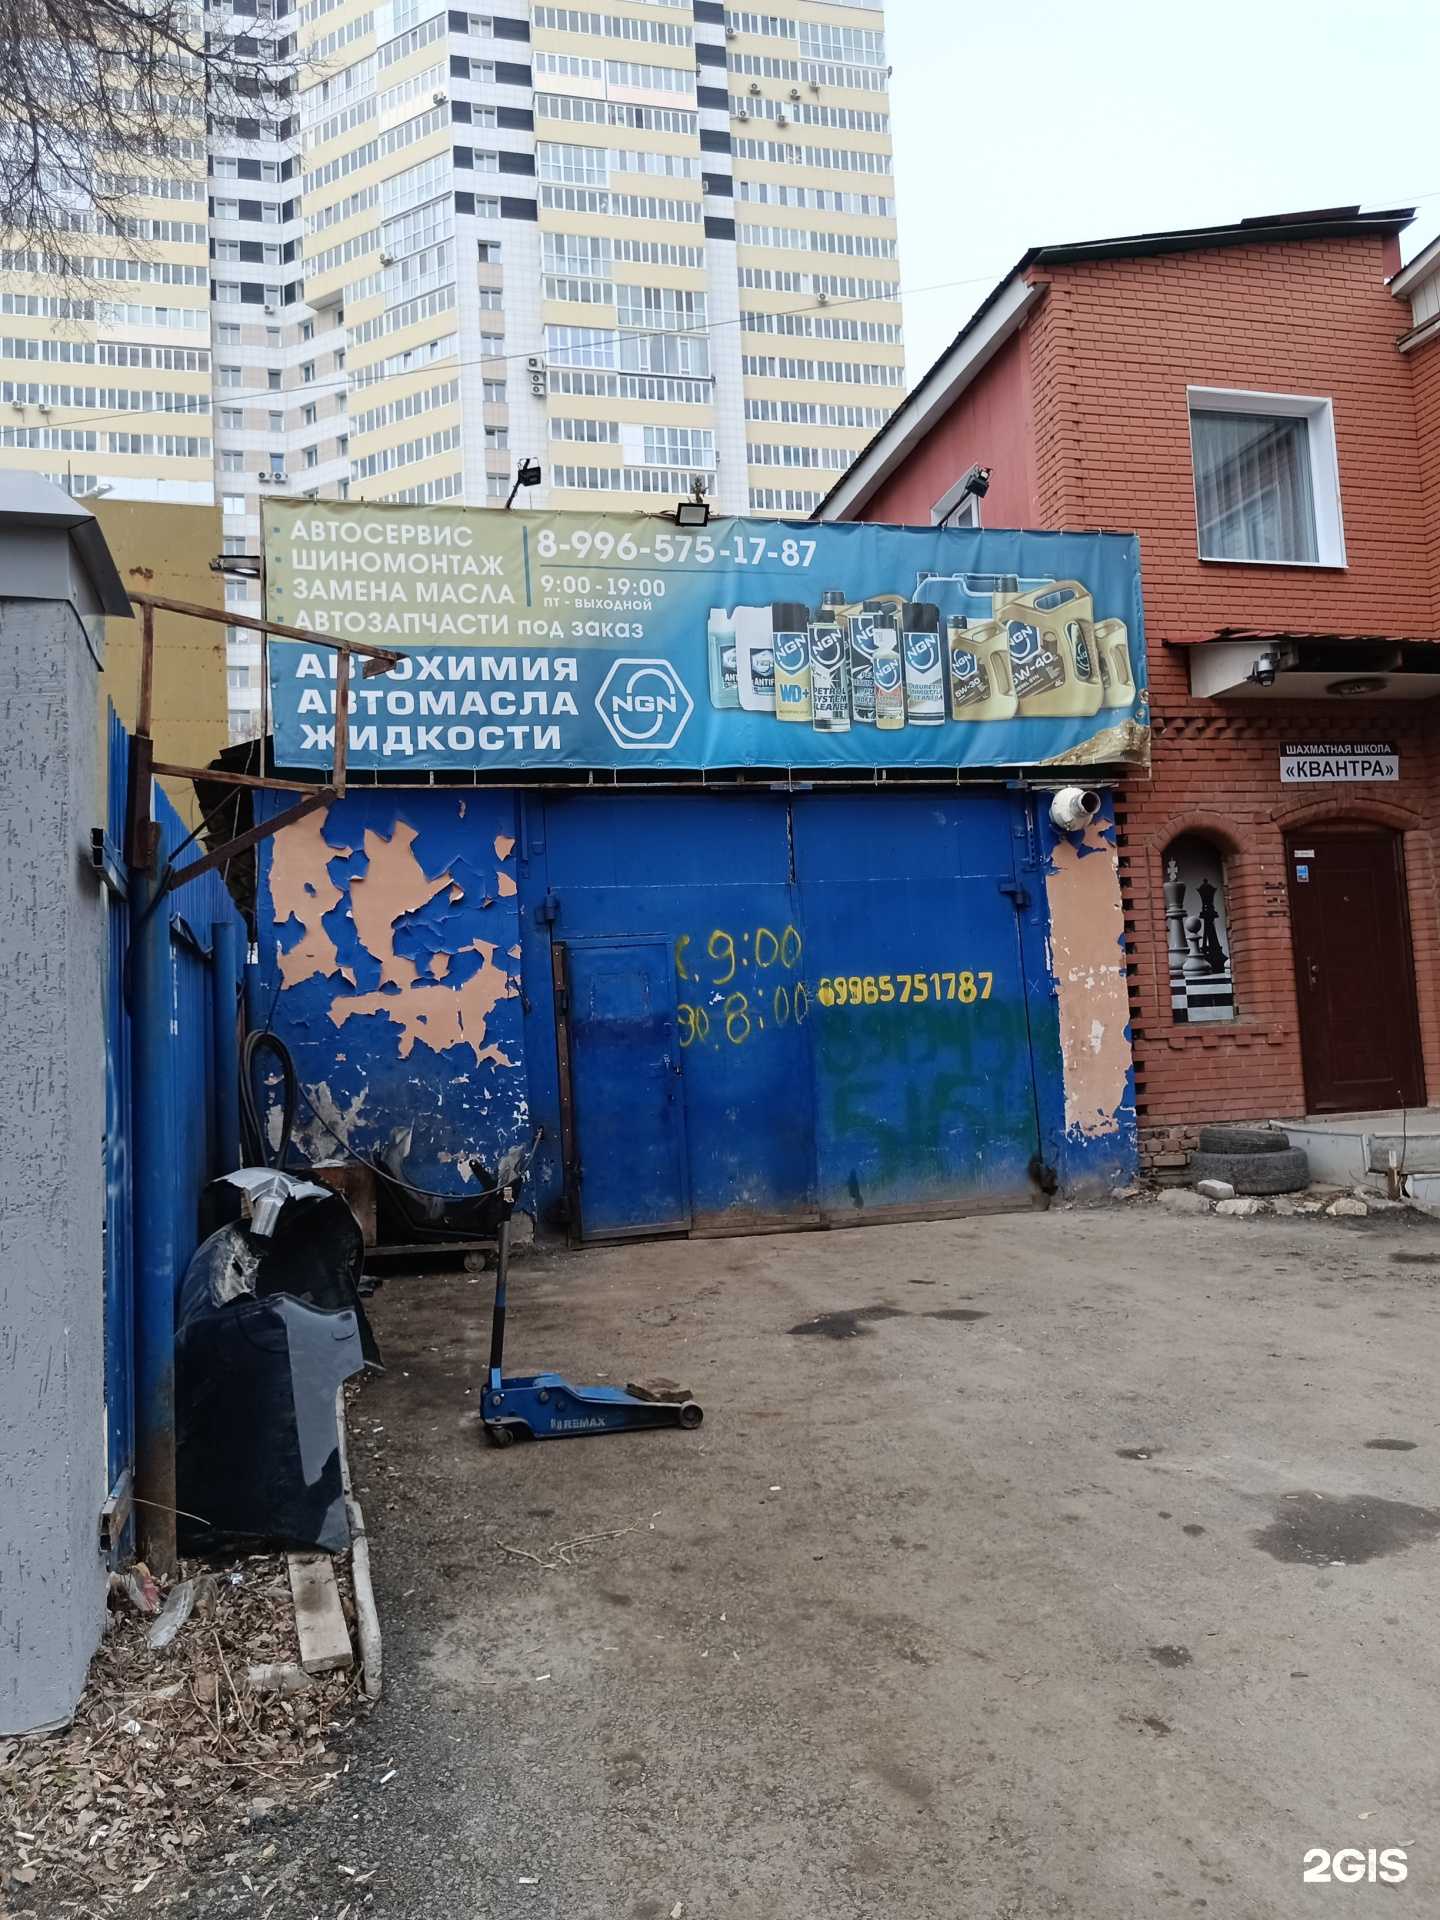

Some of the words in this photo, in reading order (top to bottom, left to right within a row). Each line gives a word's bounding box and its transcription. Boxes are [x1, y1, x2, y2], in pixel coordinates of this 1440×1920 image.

[290, 520, 473, 547] АВТОСЕРВИС
[537, 530, 816, 567] 8-996-575-17-87
[291, 551, 504, 576] ШИНОМОНТАЖ
[292, 578, 404, 602] ЗАМЕНА
[416, 582, 515, 605] МАСЛА
[607, 577, 666, 597] 19:00
[294, 609, 509, 635] АВТОЗАПЧАСТИ
[518, 619, 564, 639] под
[571, 621, 644, 639] заказ
[776, 635, 806, 658] NGN
[812, 629, 842, 655] NGN
[907, 635, 936, 660] NGN
[875, 659, 898, 678] NGN
[953, 654, 971, 669] NGN
[297, 688, 579, 716] АВТОМАСЛА
[612, 695, 677, 713] NGN
[300, 724, 561, 756] ЖИДКОСТИ
[1286, 744, 1351, 754] ШАХМАТНАЯ
[1354, 744, 1391, 753] ШКОЛА
[1286, 760, 1394, 777] «КВАНТРА»
[708, 925, 801, 985] 9:00
[724, 982, 808, 1044] 8:00
